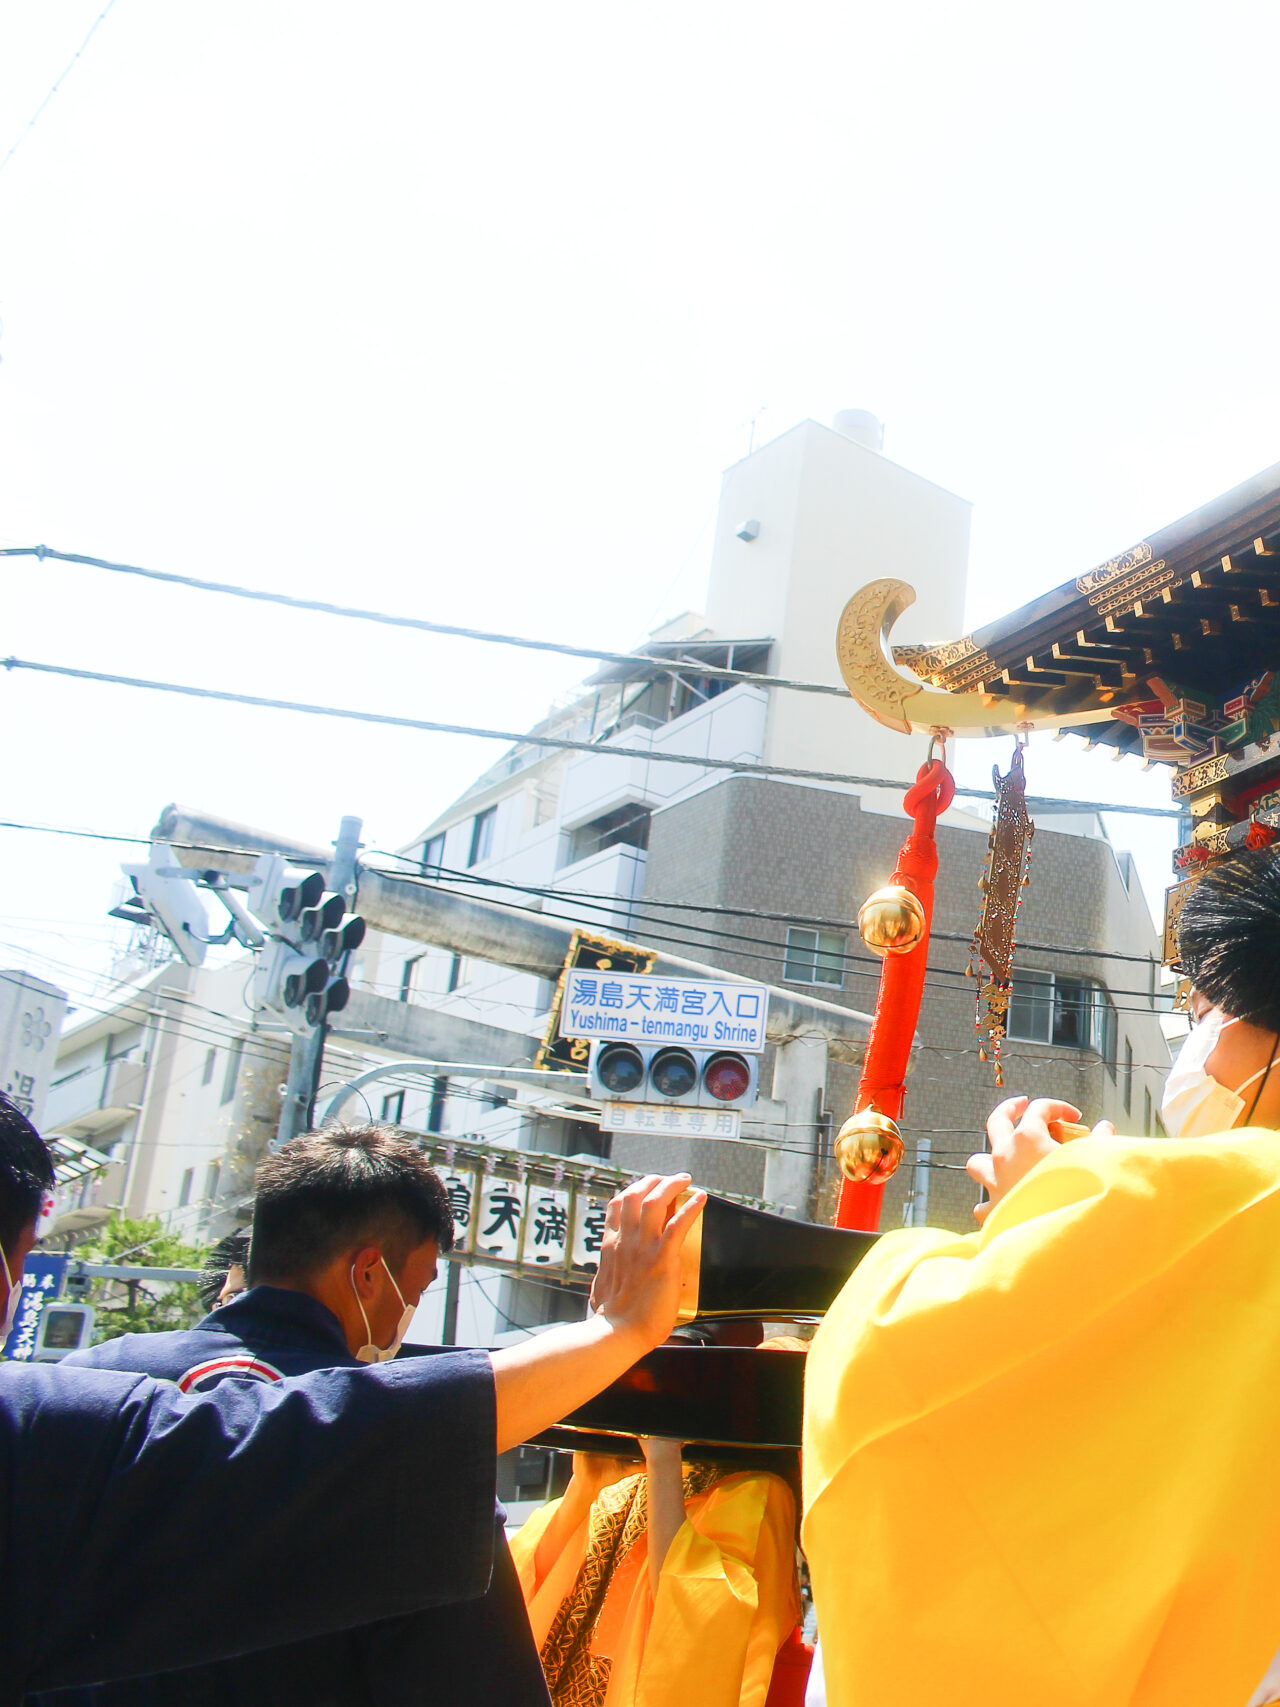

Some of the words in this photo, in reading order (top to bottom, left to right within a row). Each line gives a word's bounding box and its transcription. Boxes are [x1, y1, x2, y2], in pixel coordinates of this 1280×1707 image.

[570, 978, 760, 1019] 湯島天満宮入口
[714, 1020, 757, 1043] Shrine
[610, 1106, 734, 1134] 自転車専用
